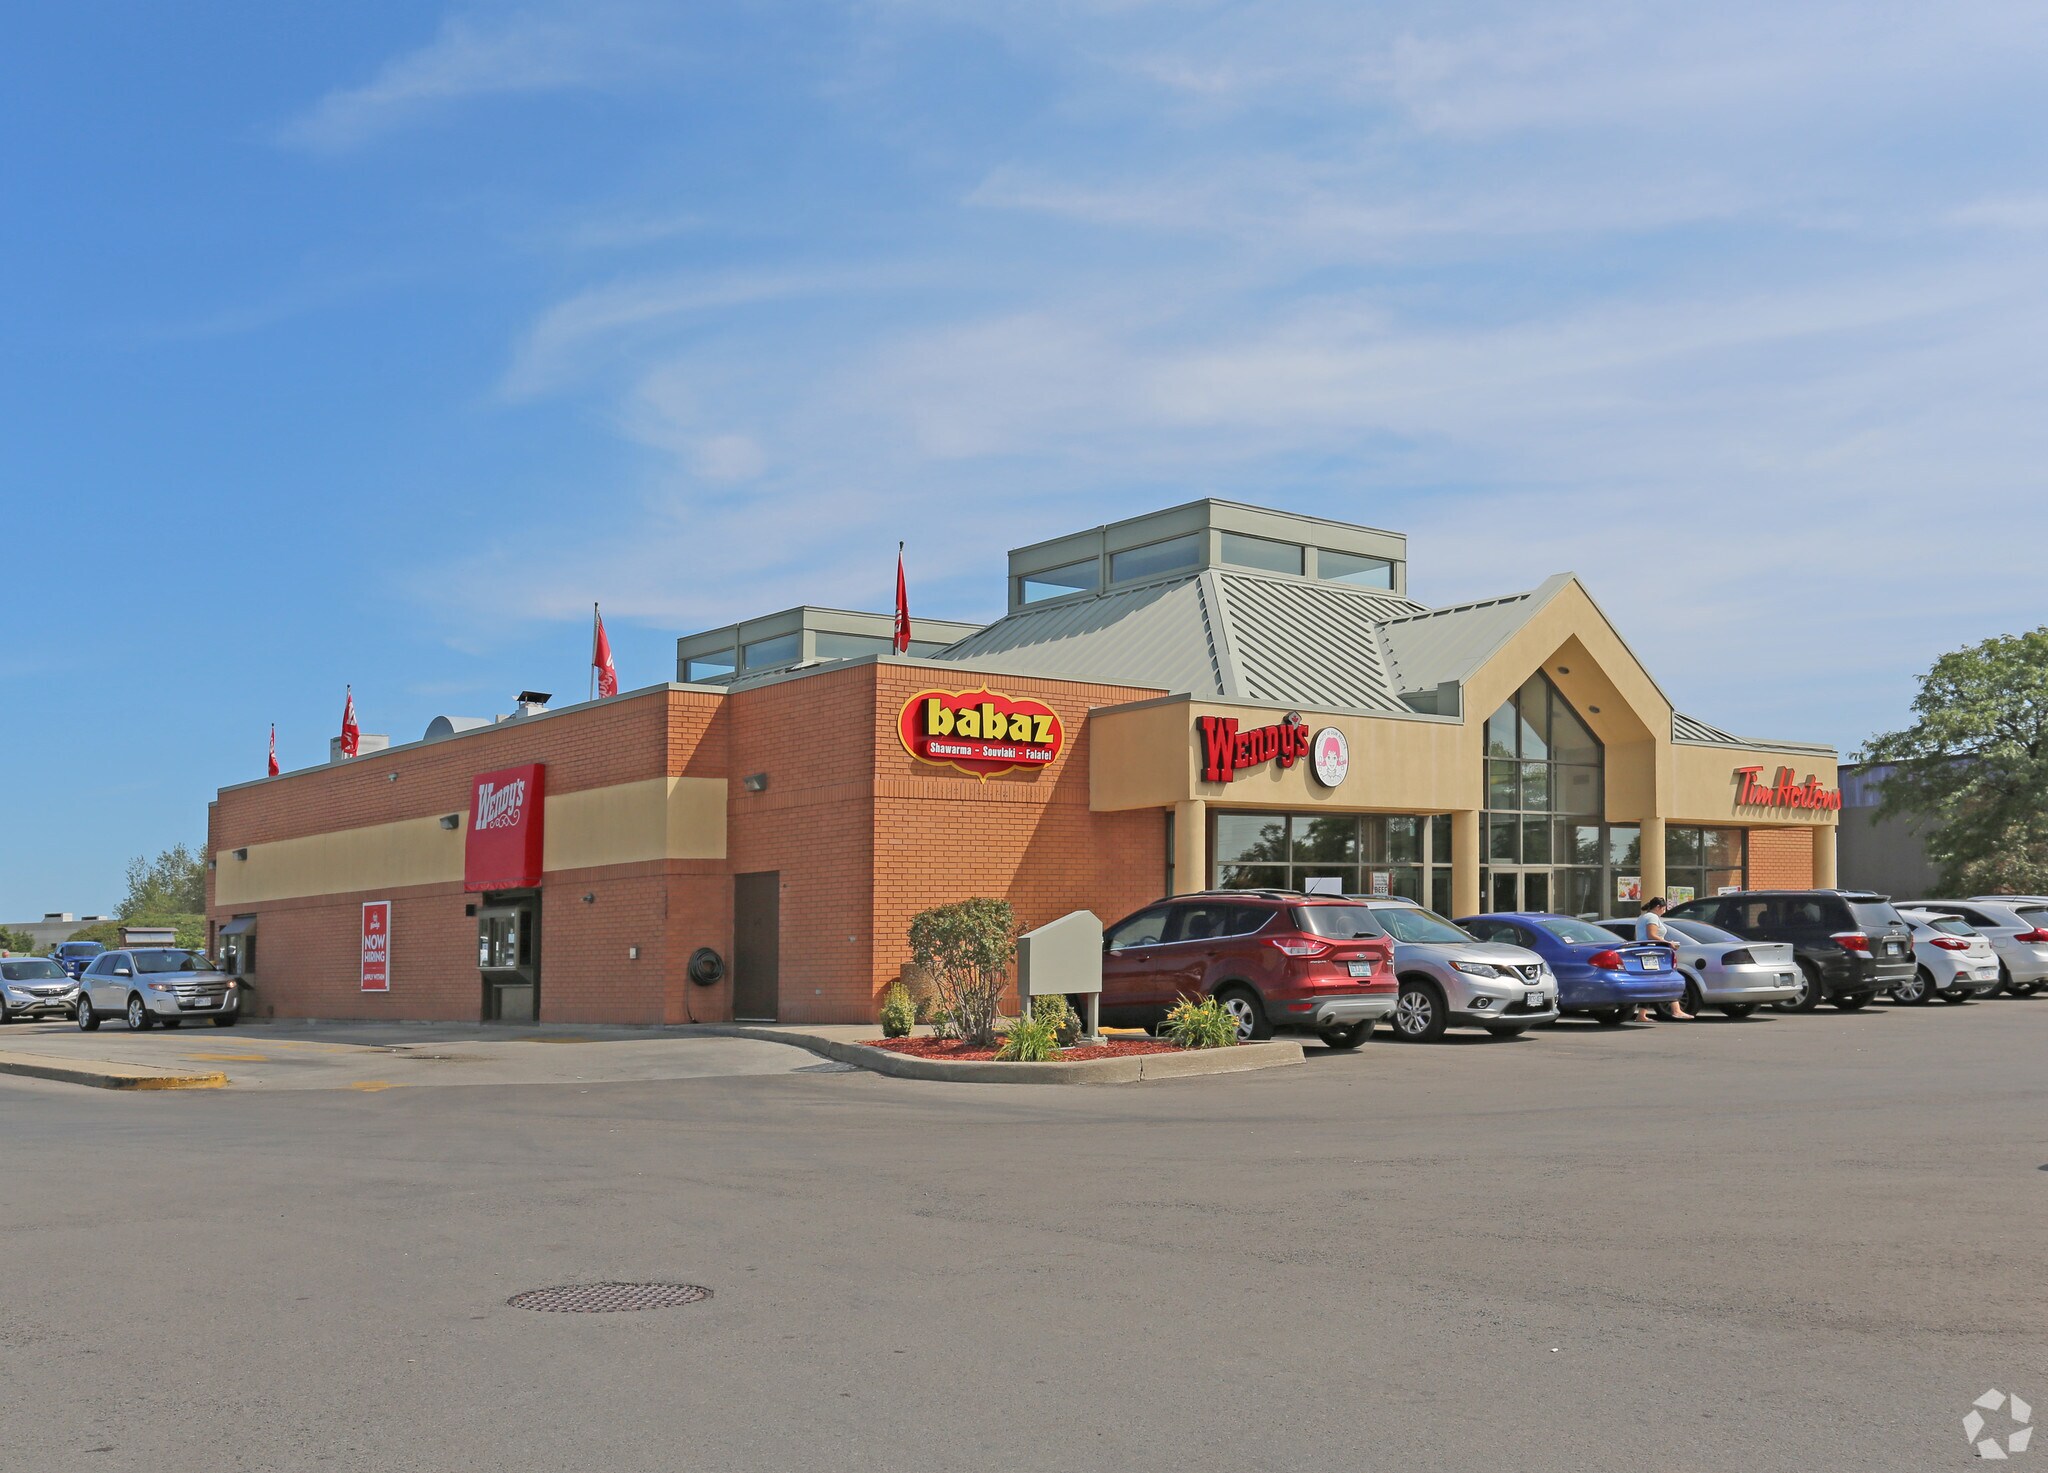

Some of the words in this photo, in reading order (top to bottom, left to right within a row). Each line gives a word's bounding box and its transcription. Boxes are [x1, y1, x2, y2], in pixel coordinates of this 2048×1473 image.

[926, 698, 1054, 743] babaz
[930, 742, 972, 756] Shawarma
[982, 746, 1016, 759] Souvlaki
[1025, 748, 1052, 761] Falafel
[1201, 716, 1309, 782] Wendy's
[475, 779, 525, 830] Wendy's
[1739, 766, 1774, 807] Tim
[1776, 766, 1842, 810] Hortons
[364, 934, 386, 950] NOW
[364, 951, 385, 963] HIRING
